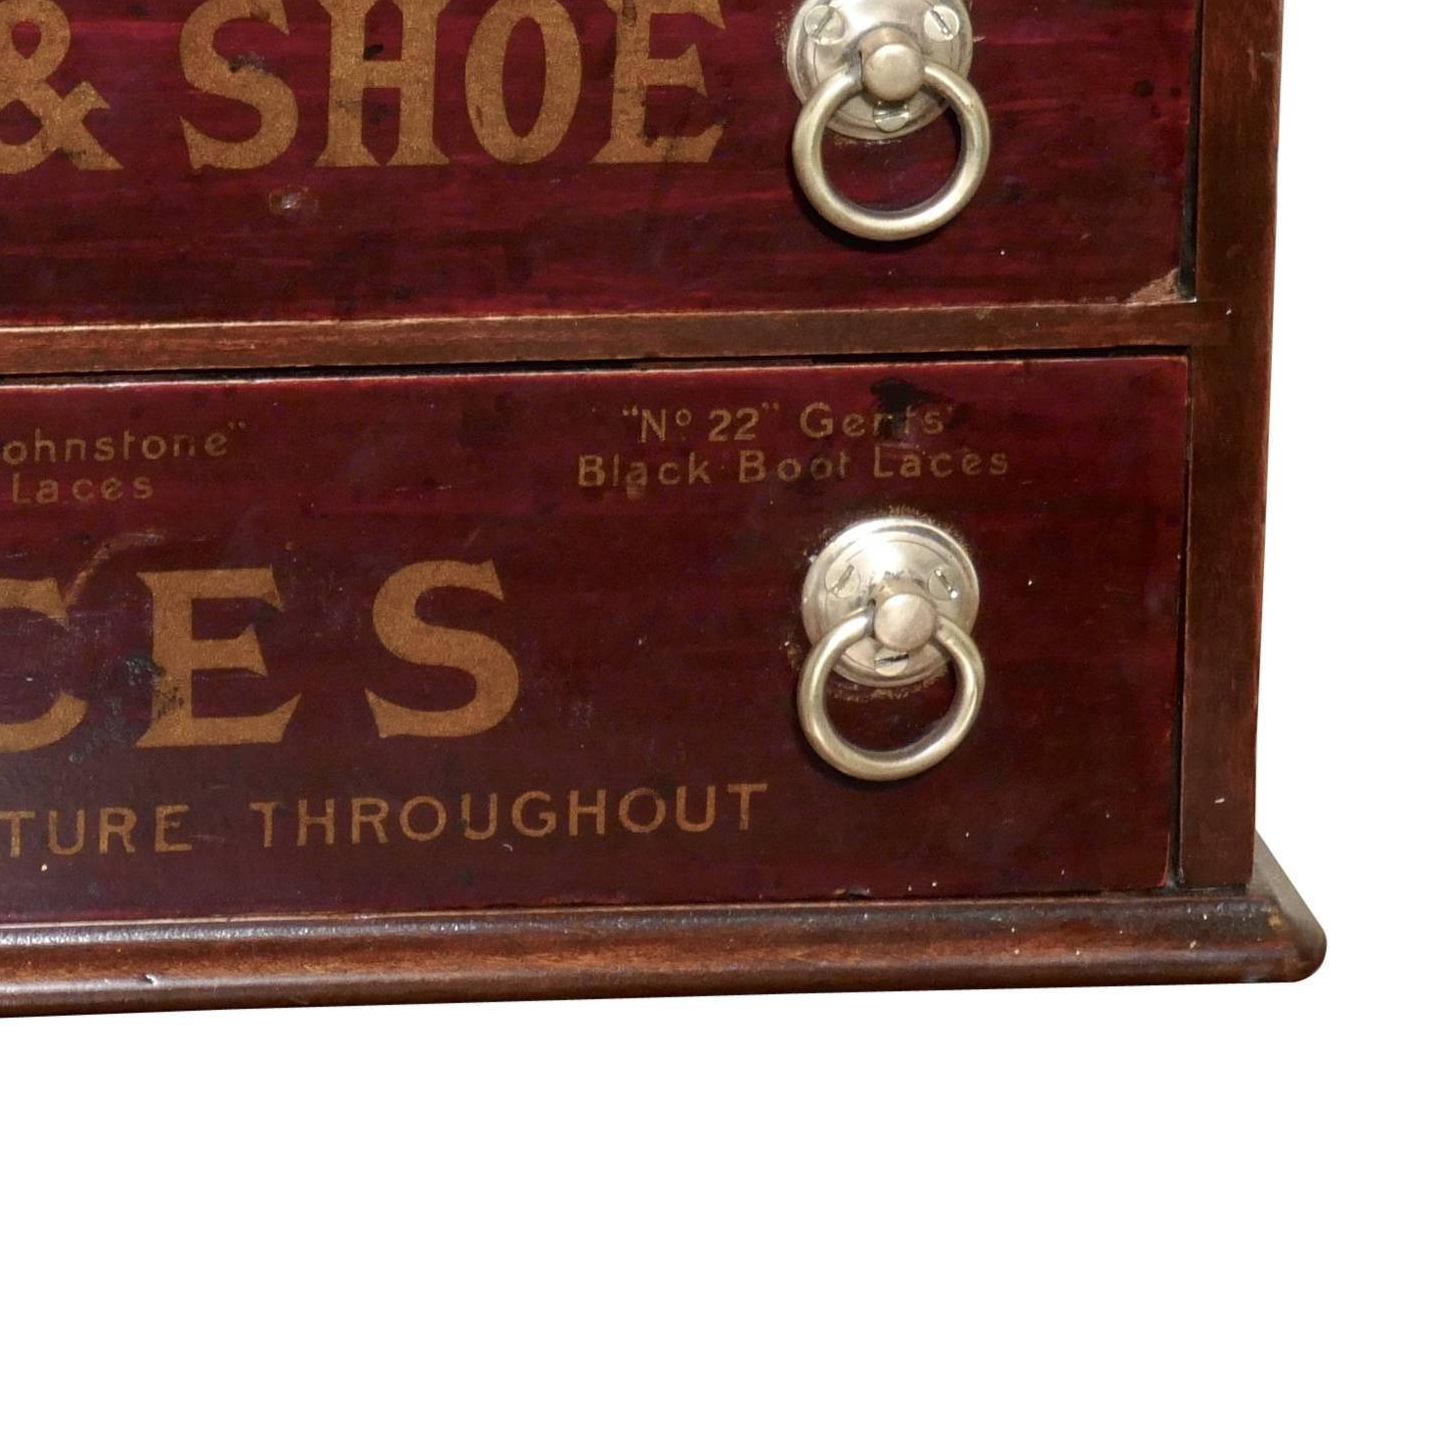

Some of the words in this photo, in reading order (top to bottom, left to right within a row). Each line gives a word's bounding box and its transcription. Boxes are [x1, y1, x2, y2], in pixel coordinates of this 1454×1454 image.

[708, 402, 780, 442] 22"
[578, 451, 712, 488] Black
[738, 449, 849, 484] Boot
[872, 445, 1009, 479] Laces
[11, 471, 154, 506] Laces
[249, 783, 768, 848] THROUGHOUT
